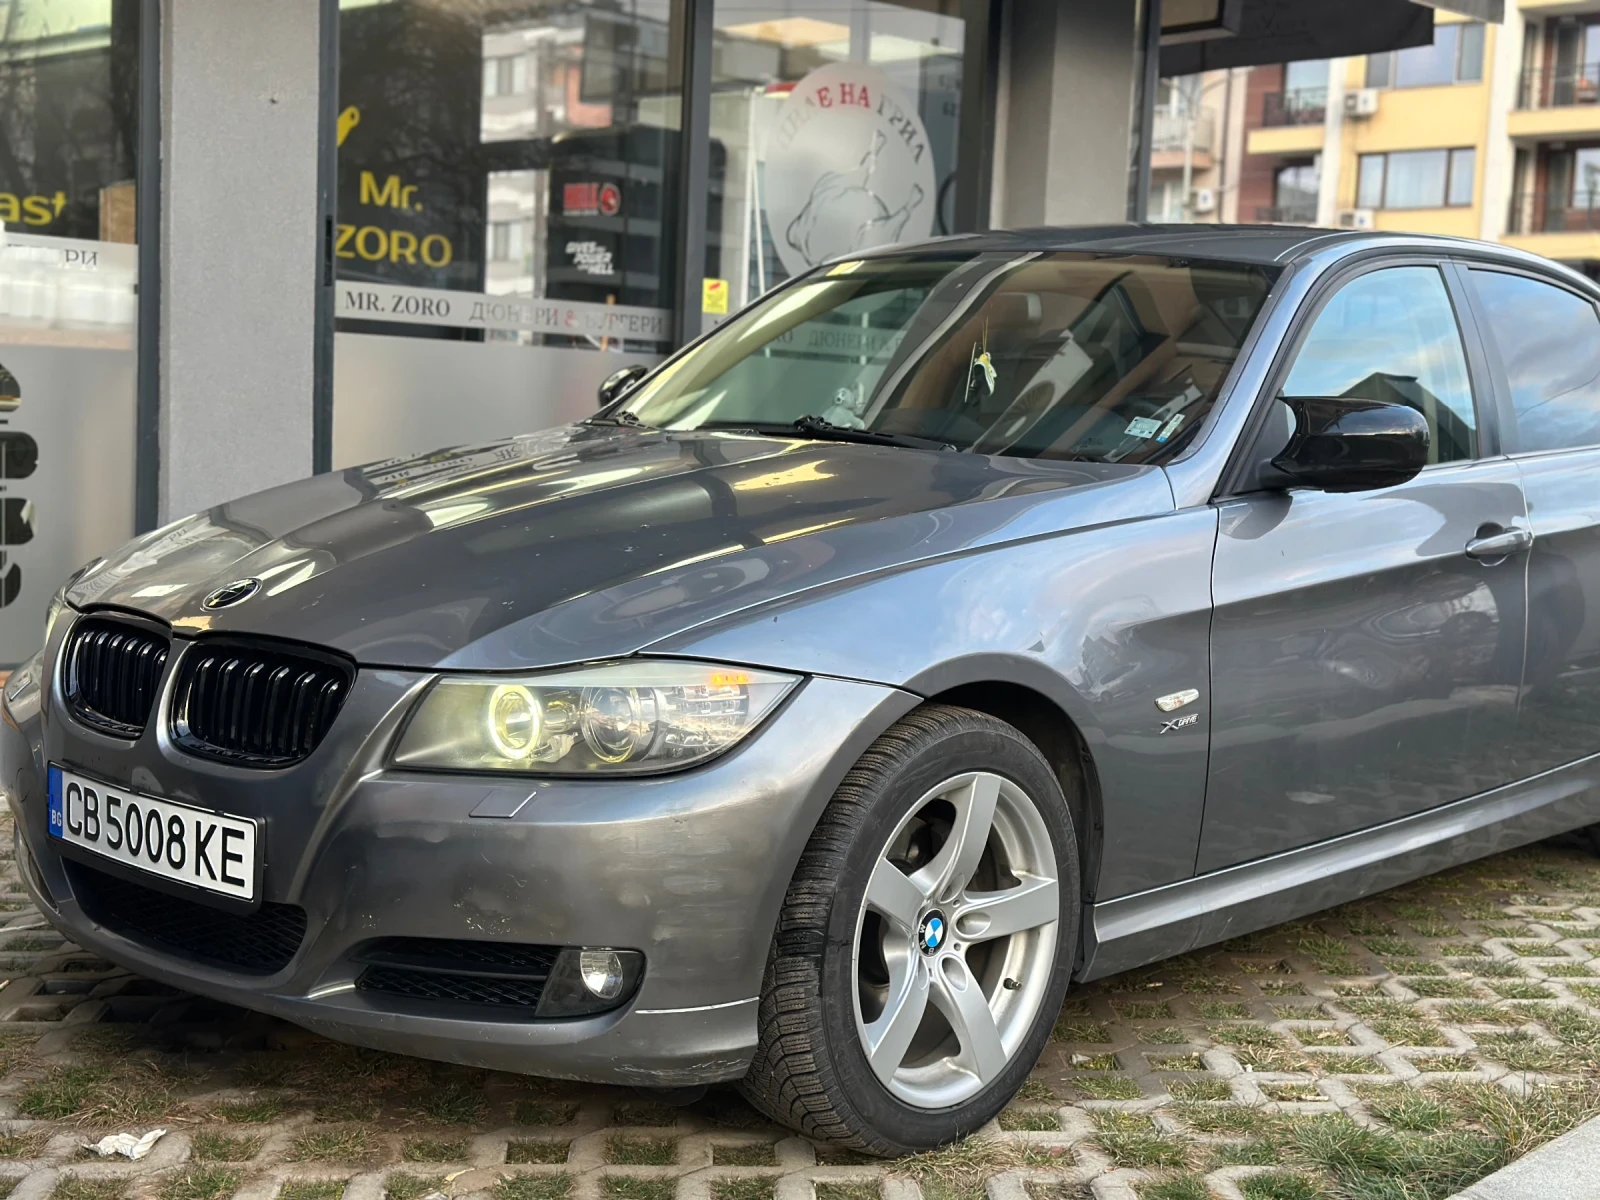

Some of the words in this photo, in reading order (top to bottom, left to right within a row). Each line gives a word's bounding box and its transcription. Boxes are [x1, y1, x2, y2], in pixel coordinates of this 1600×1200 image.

[839, 82, 871, 109] НА
[360, 170, 423, 212] Mr.
[335, 223, 453, 269] ZORO
[345, 291, 386, 313] MR.
[391, 294, 450, 317] ZORO
[51, 808, 62, 827] BG
[106, 794, 186, 870] 5008
